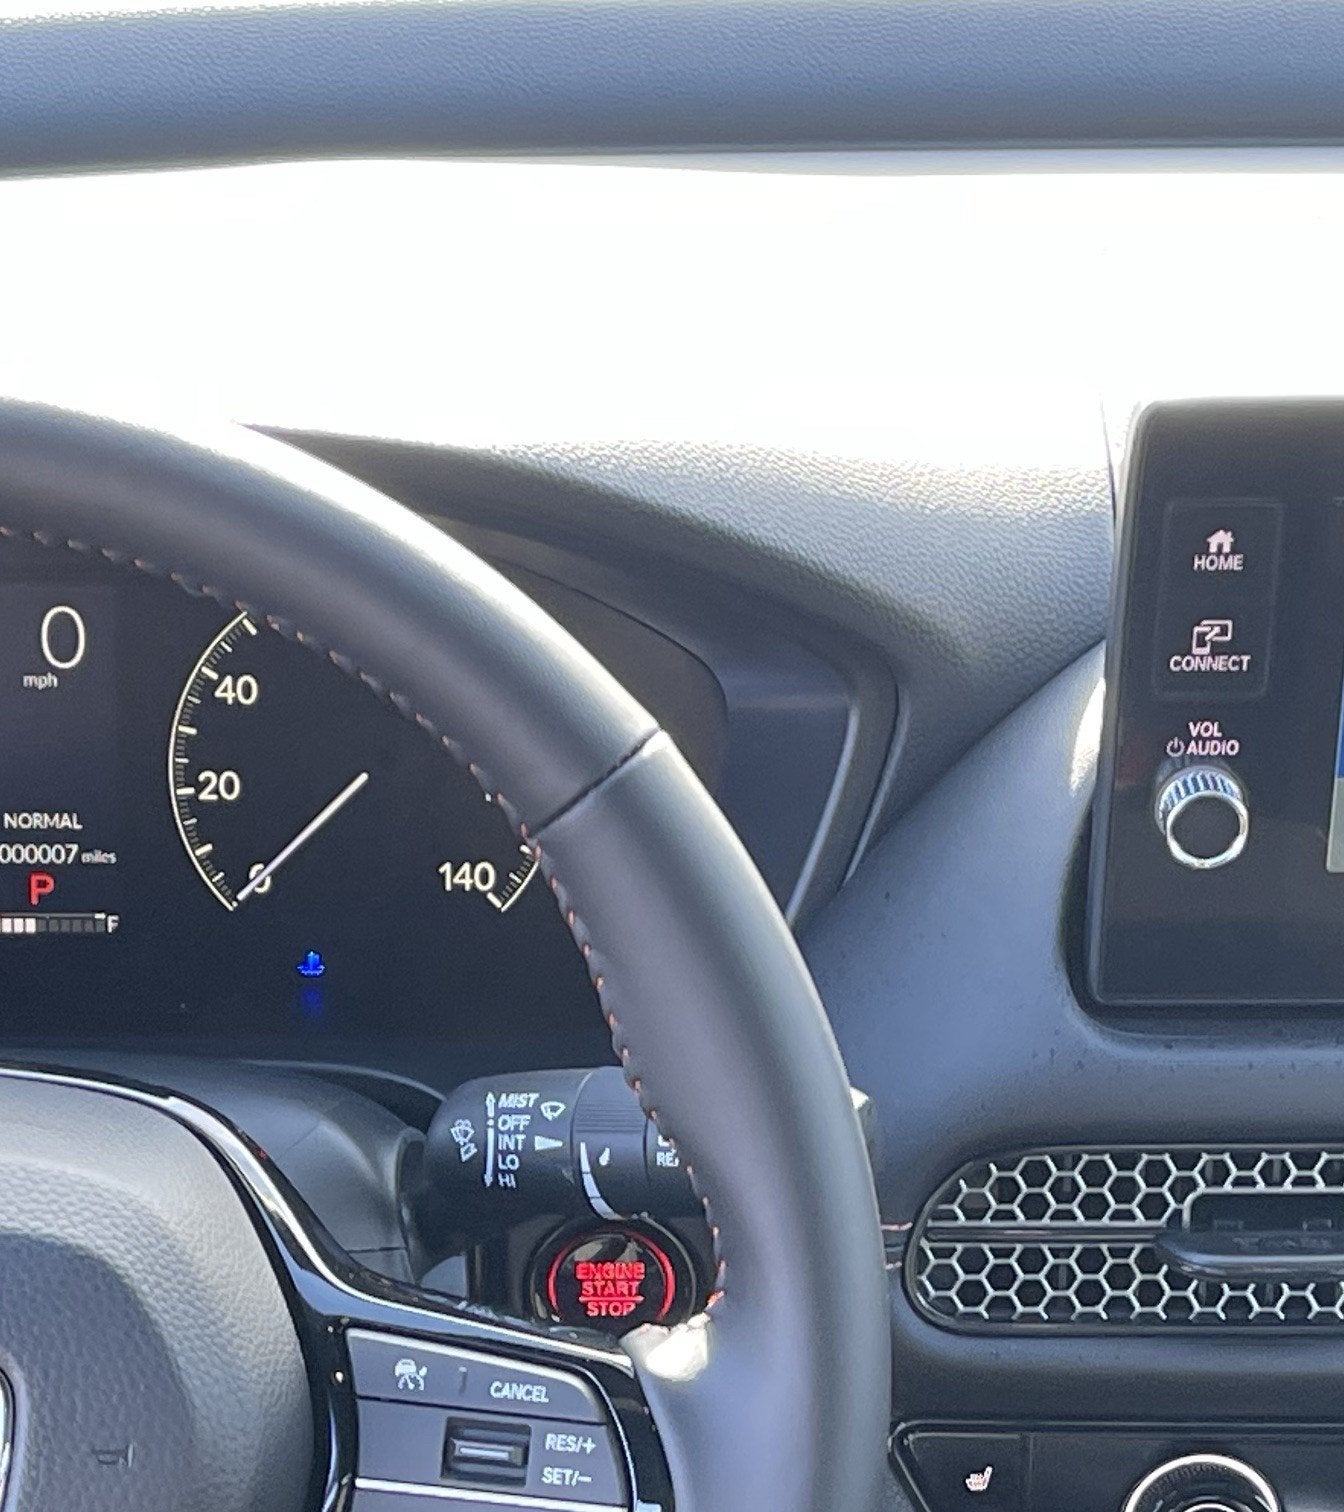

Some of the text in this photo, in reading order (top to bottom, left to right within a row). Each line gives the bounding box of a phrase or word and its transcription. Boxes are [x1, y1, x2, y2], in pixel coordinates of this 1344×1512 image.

[1193, 554, 1244, 572] HOME
[40, 605, 86, 669] 0
[1169, 654, 1251, 672] CONNECT
[23, 672, 58, 690] mph
[214, 673, 259, 706] 40
[1188, 721, 1222, 738] VOL
[1186, 739, 1240, 757] AUDIO
[197, 770, 241, 801] 20
[4, 812, 83, 830] NORMAL
[80, 849, 117, 864] miles
[438, 861, 496, 892] 140
[29, 872, 55, 905] P
[106, 914, 119, 934] F
[498, 1092, 540, 1109] MIST
[497, 1114, 531, 1132] OFF
[497, 1134, 526, 1151] INT
[498, 1154, 520, 1170] LO
[498, 1173, 516, 1188] HI
[575, 1260, 646, 1281] ENGINE
[581, 1280, 641, 1297] START
[586, 1301, 637, 1318] STOP
[490, 1381, 550, 1403] CANCEL
